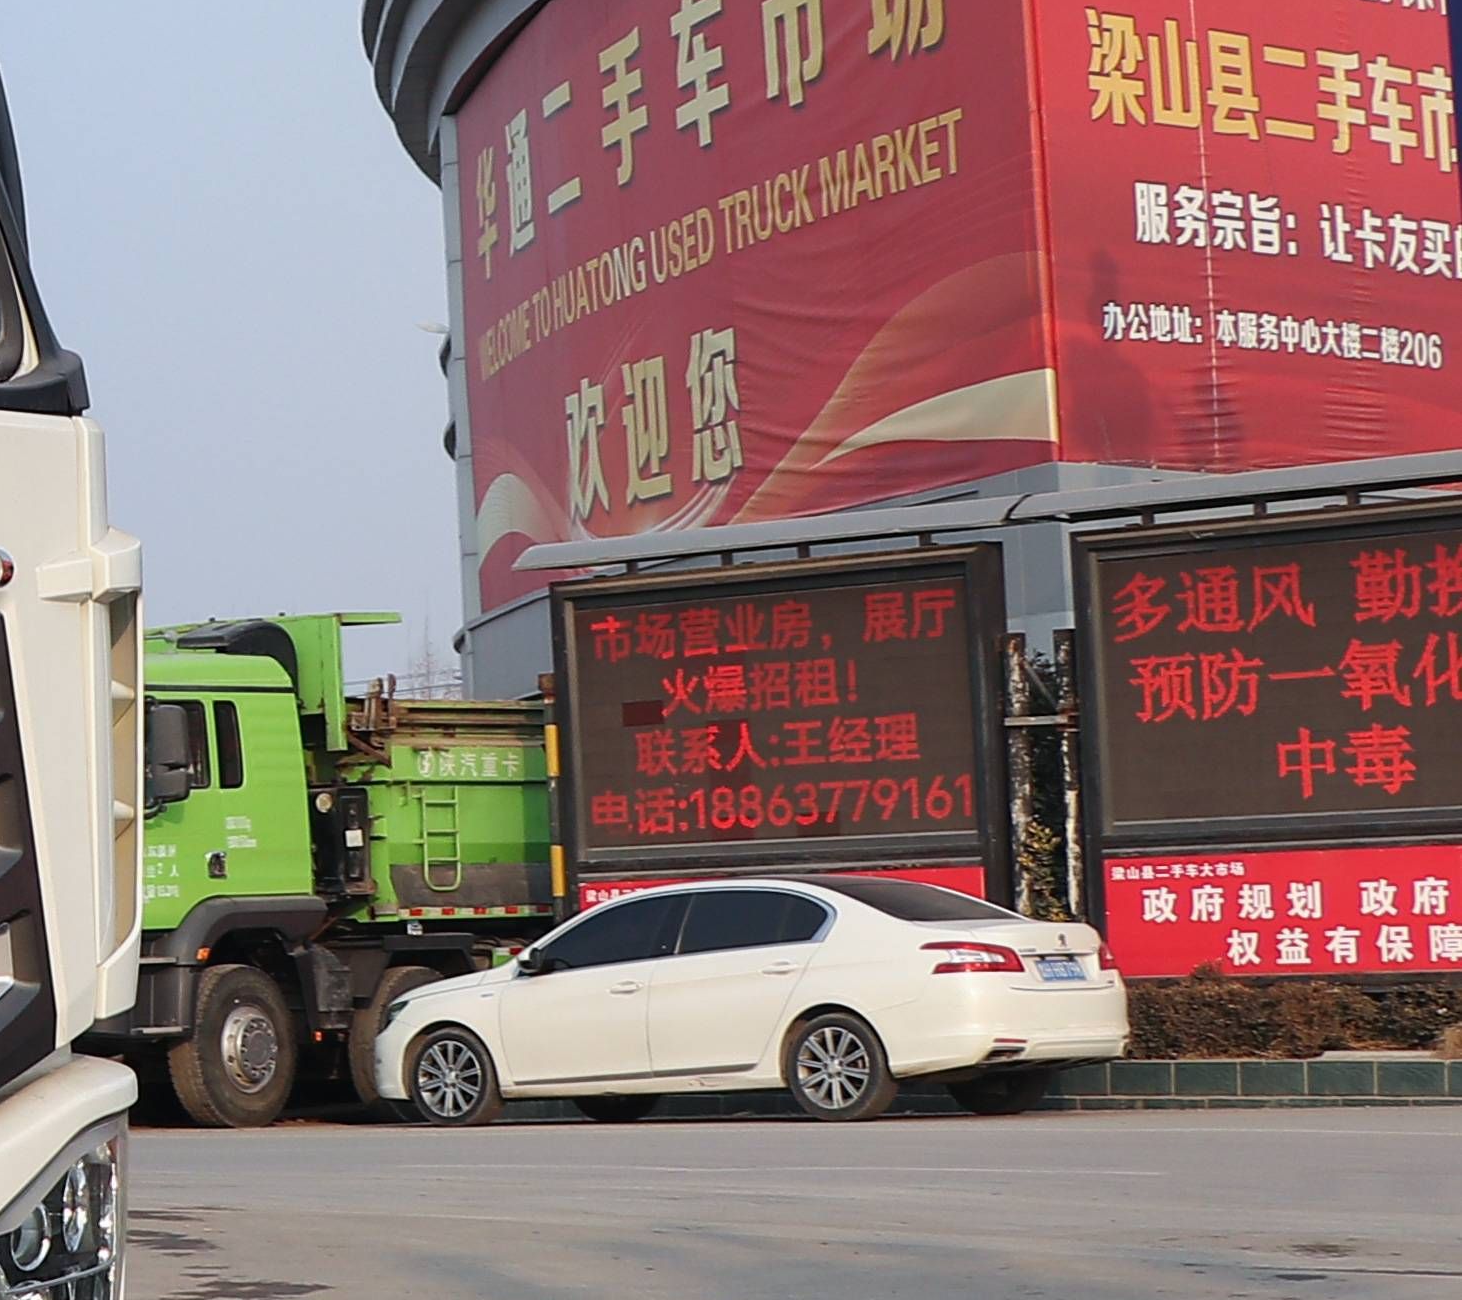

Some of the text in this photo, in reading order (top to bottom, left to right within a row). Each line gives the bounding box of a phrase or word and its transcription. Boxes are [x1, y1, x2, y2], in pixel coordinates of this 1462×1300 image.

[1085, 6, 1459, 173] 梁山县二手车市
[532, 285, 552, 343] TO
[552, 236, 647, 331] HUATONG
[651, 205, 716, 284] USED
[718, 163, 815, 254] TRUCK
[818, 107, 963, 218] MARKET
[1134, 181, 1462, 280] 服务宗旨：让卡友买
[565, 327, 743, 520] 欢迎您
[1112, 562, 1316, 644] 多通风
[661, 658, 858, 717] 火爆招租！
[438, 750, 520, 777] 陕汽重卡
[635, 712, 921, 777] 联系人:王经理
[1277, 723, 1416, 800] 中毒
[590, 773, 974, 836] 电话:18863779161
[1111, 861, 1245, 881] 梁山县二手车大市场
[1141, 876, 1450, 923] 政府规划 政府
[1227, 923, 1462, 966] 权益有保障
